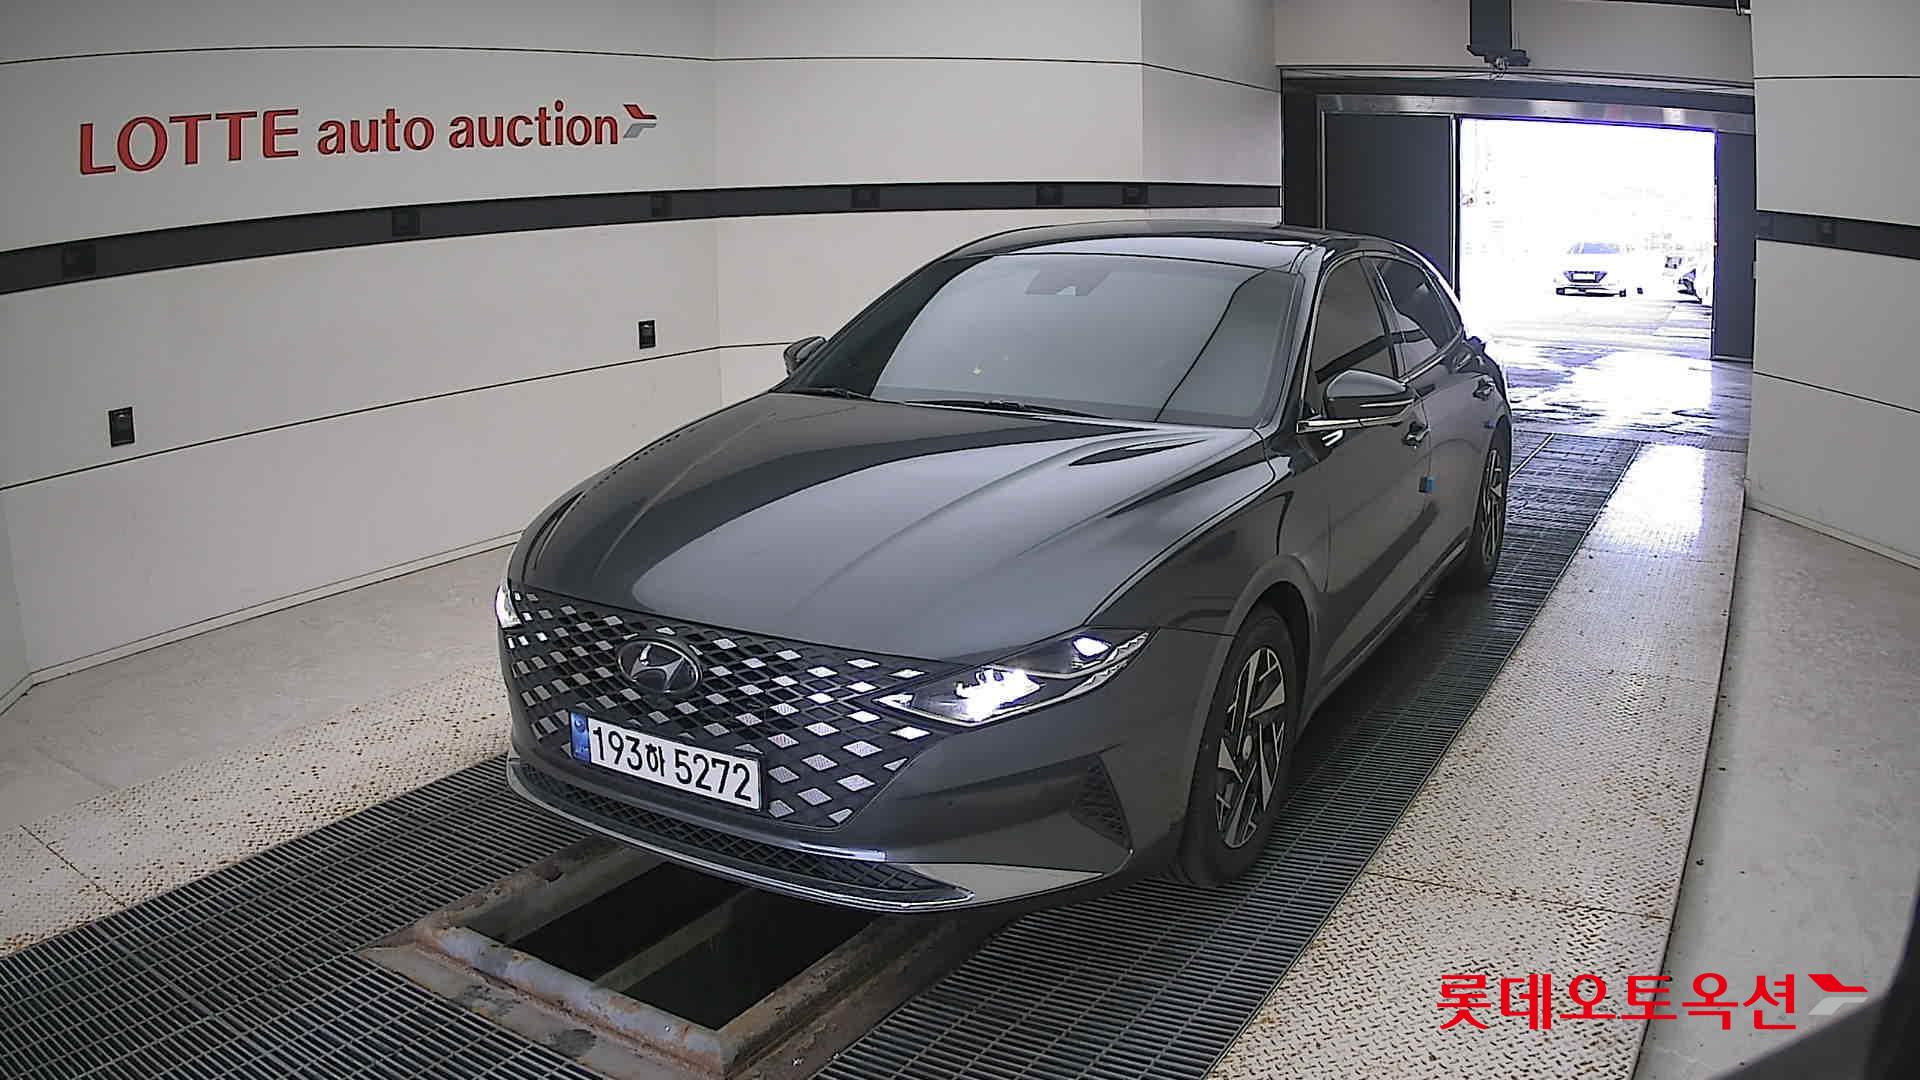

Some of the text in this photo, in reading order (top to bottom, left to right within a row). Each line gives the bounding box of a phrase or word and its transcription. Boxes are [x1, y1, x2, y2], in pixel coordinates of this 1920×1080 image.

[79, 100, 619, 175] LOTTE auto auction
[592, 726, 752, 802] 193하 5272
